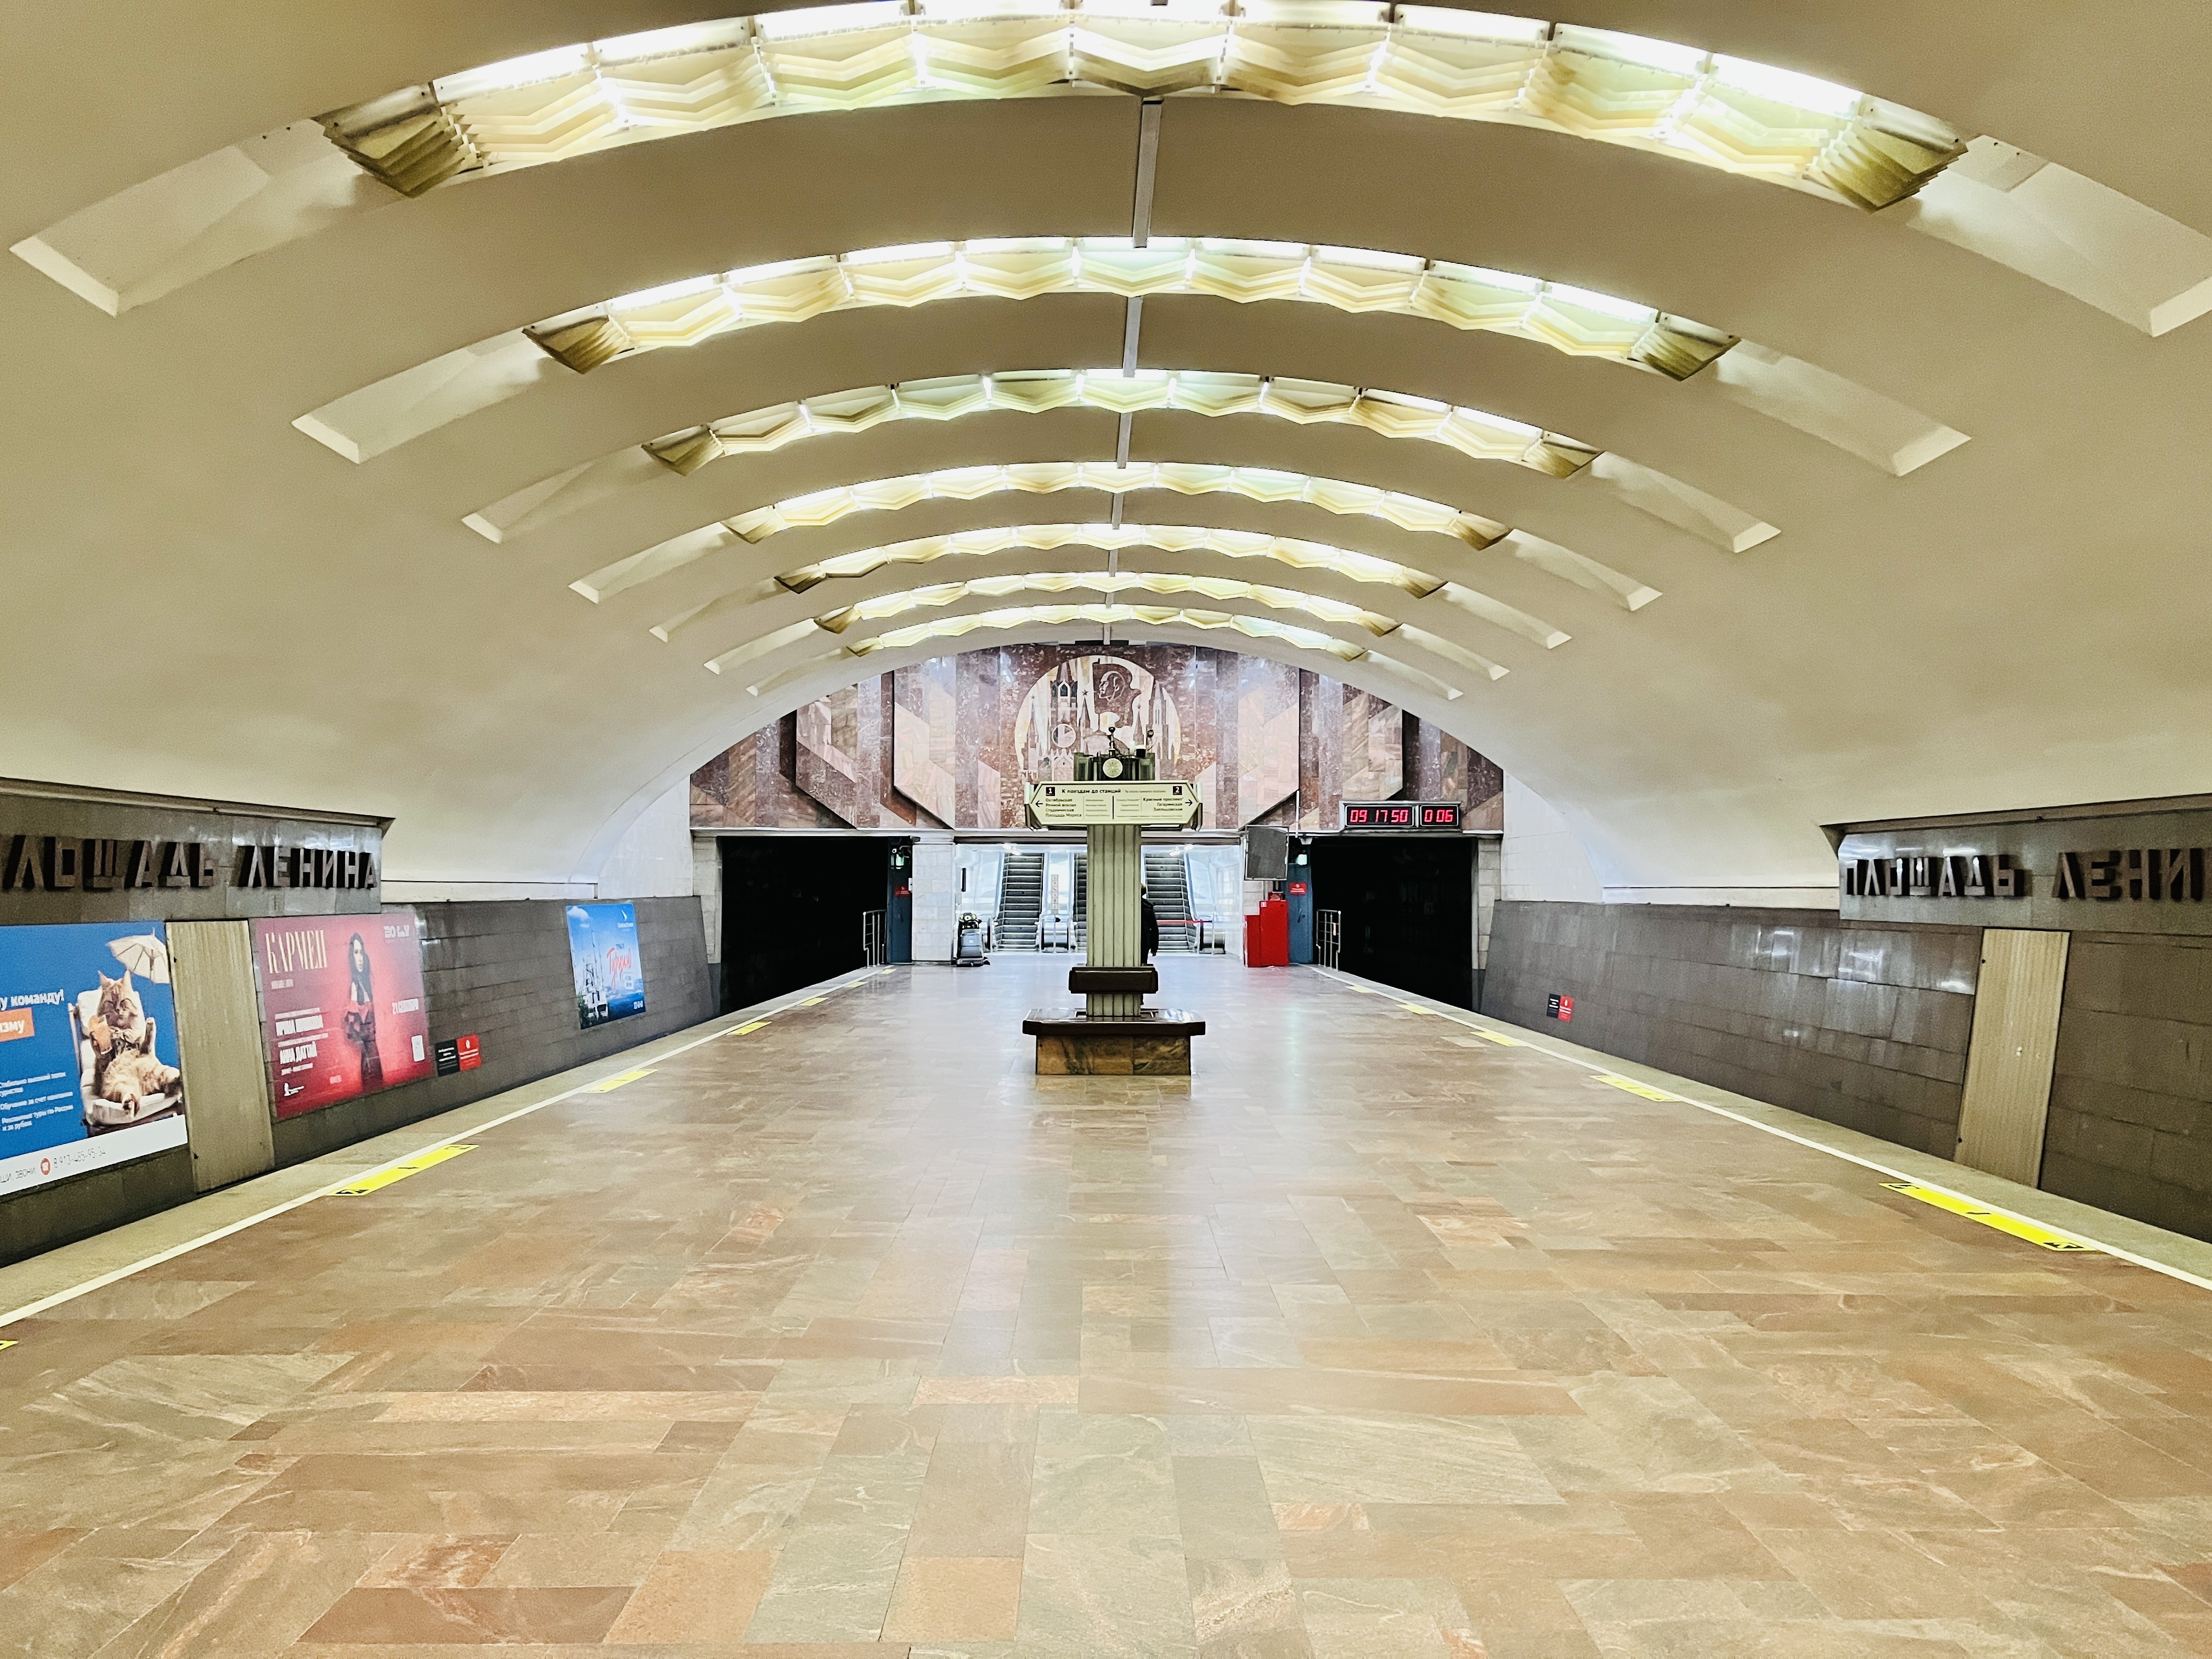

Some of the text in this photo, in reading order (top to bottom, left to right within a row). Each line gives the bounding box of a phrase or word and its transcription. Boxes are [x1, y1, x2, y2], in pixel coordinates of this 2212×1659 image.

[244, 845, 377, 888] ЛЕНИНА
[1844, 855, 2016, 896] ПЛОЩАДЬ
[266, 929, 328, 974] КАРМЕН
[11, 989, 65, 1006] команду!
[54, 1158, 58, 1168] 8
